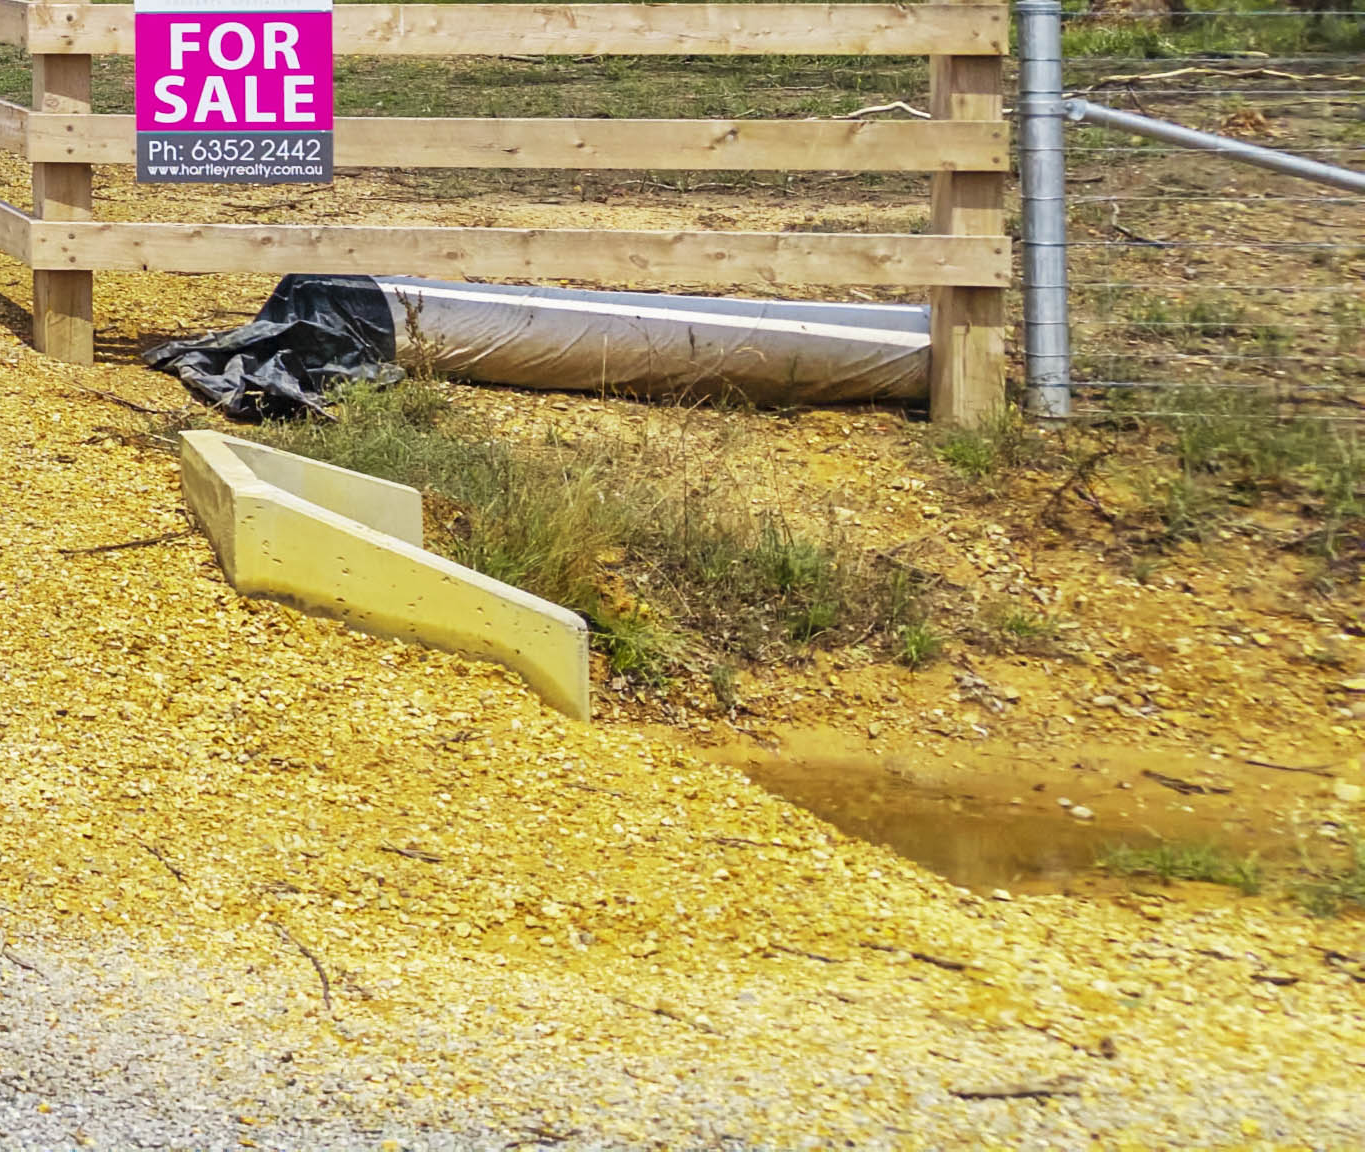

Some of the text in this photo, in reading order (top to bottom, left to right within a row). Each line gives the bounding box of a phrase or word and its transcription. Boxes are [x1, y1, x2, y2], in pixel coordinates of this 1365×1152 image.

[170, 21, 301, 71] FOR
[153, 75, 316, 123] SALE
[148, 139, 321, 161] Ph: 6352 2442
[147, 163, 323, 178] www.hartleyrealty.com.au
